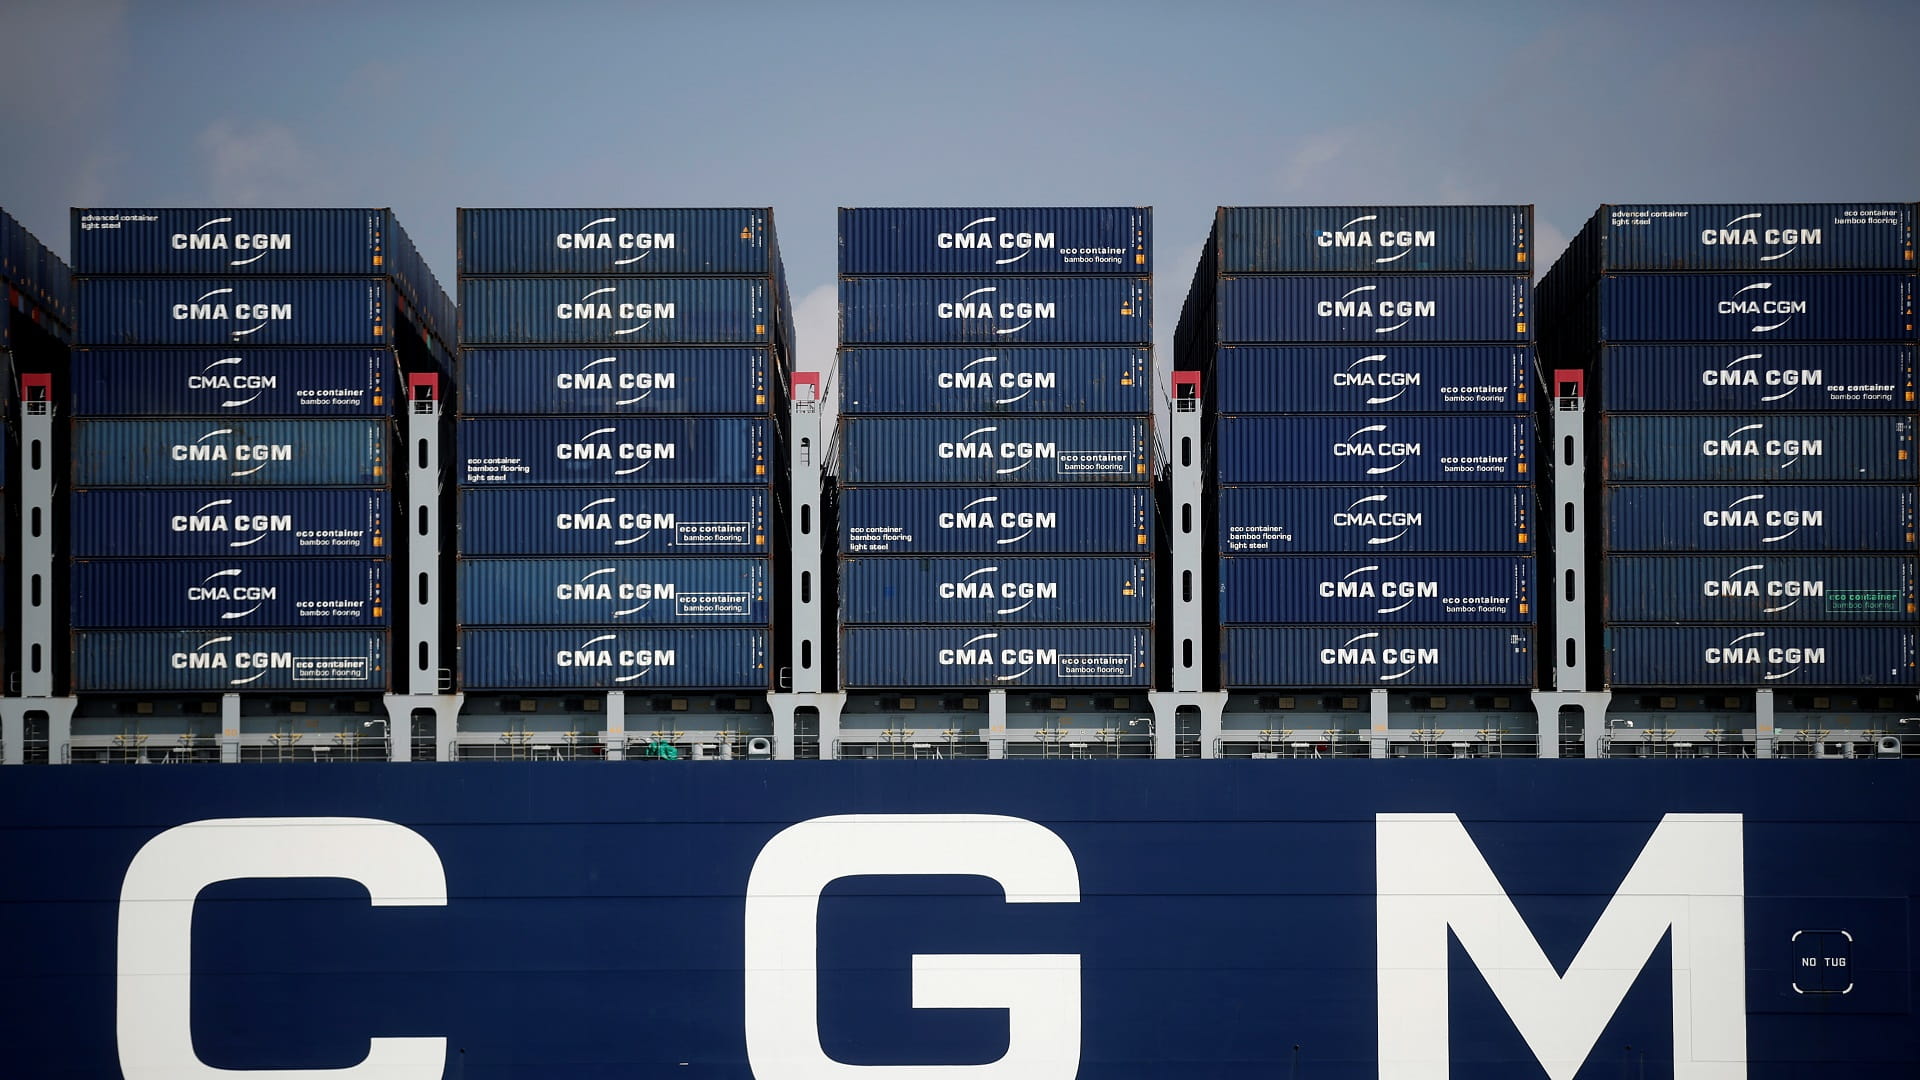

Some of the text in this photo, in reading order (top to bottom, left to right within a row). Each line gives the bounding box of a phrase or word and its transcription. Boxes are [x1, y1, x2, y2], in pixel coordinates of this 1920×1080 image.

[172, 234, 290, 250] CMA CGM
[557, 234, 674, 248] CMA CGM
[938, 233, 1054, 248] CMA CGM
[1318, 231, 1434, 248] CMA CGM
[1702, 229, 1822, 246] CMA CGM
[173, 304, 292, 320] CMA CGM
[558, 303, 674, 320] CMA CGM
[938, 303, 1054, 318] CMA CGM
[1318, 301, 1434, 318] CMA CGM
[1719, 301, 1806, 314] CMA CGM
[189, 376, 276, 388] CMA CGM
[558, 373, 674, 390] CMA CGM
[939, 373, 1056, 388] CMA CGM
[1334, 373, 1420, 386] CMA CGM
[1703, 370, 1822, 386] CMA CGM
[316, 388, 364, 396] container
[1862, 393, 1892, 401] flooring
[172, 445, 292, 460] CMA CGM
[557, 443, 674, 460] CMA CGM
[939, 443, 1056, 458] CMA CGM
[1334, 443, 1420, 456] CMA CGM
[1704, 440, 1822, 456] CMA CGM
[172, 515, 292, 532] CMA CGM
[557, 514, 674, 530] CMA CGM
[939, 513, 1056, 528] CMA CGM
[1334, 513, 1422, 526] CMA CGM
[1704, 511, 1822, 526] CMA CGM
[188, 587, 276, 600] CMA CGM
[557, 584, 674, 600] CMA CGM
[940, 583, 1056, 598] CMA CGM
[1320, 582, 1438, 598] CMA CGM
[1704, 581, 1824, 596] CMA CGM
[172, 652, 292, 668] CMA CGM
[557, 650, 674, 666] CMA CGM
[940, 649, 1056, 664] CMA CGM
[1321, 649, 1438, 664] CMA CGM
[1706, 648, 1824, 664] CMA CGM
[316, 660, 364, 668] container
[1802, 958, 1846, 966] NO TUG
